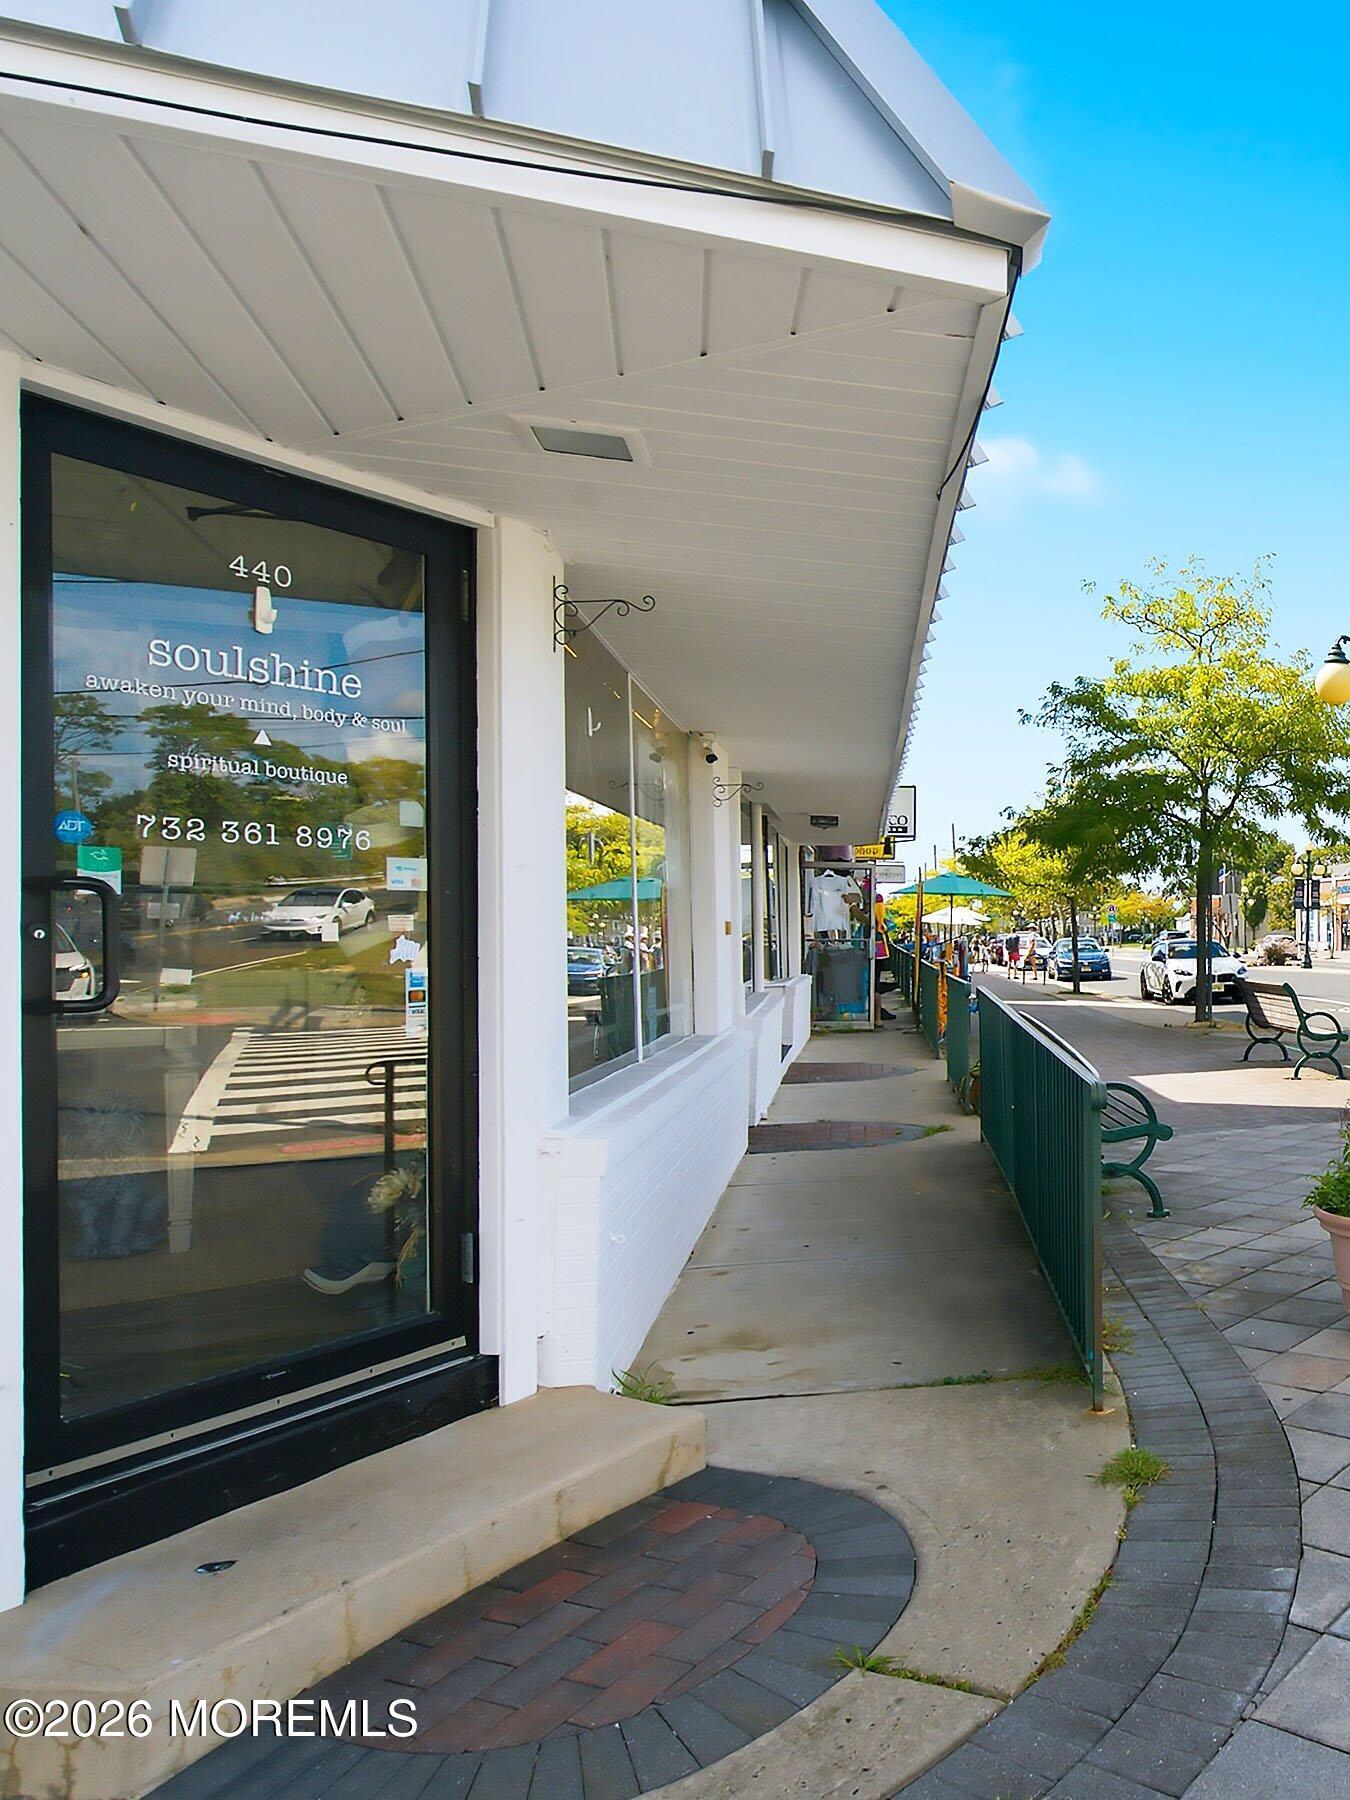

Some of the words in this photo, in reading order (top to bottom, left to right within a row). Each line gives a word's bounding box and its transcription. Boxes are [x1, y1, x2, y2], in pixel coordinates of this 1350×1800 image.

[228, 554, 293, 588] 440
[147, 638, 363, 700] soulshine
[85, 672, 176, 702] awaken
[182, 688, 235, 714] your
[239, 696, 297, 721] mind,
[302, 705, 347, 729] body
[351, 711, 367, 728] &
[371, 716, 407, 734] soul
[167, 751, 260, 777] spiritual
[264, 759, 348, 786] boutique
[57, 819, 85, 833] ADT
[136, 813, 206, 842] 732
[221, 820, 280, 847] 361
[295, 825, 372, 852] 8976
